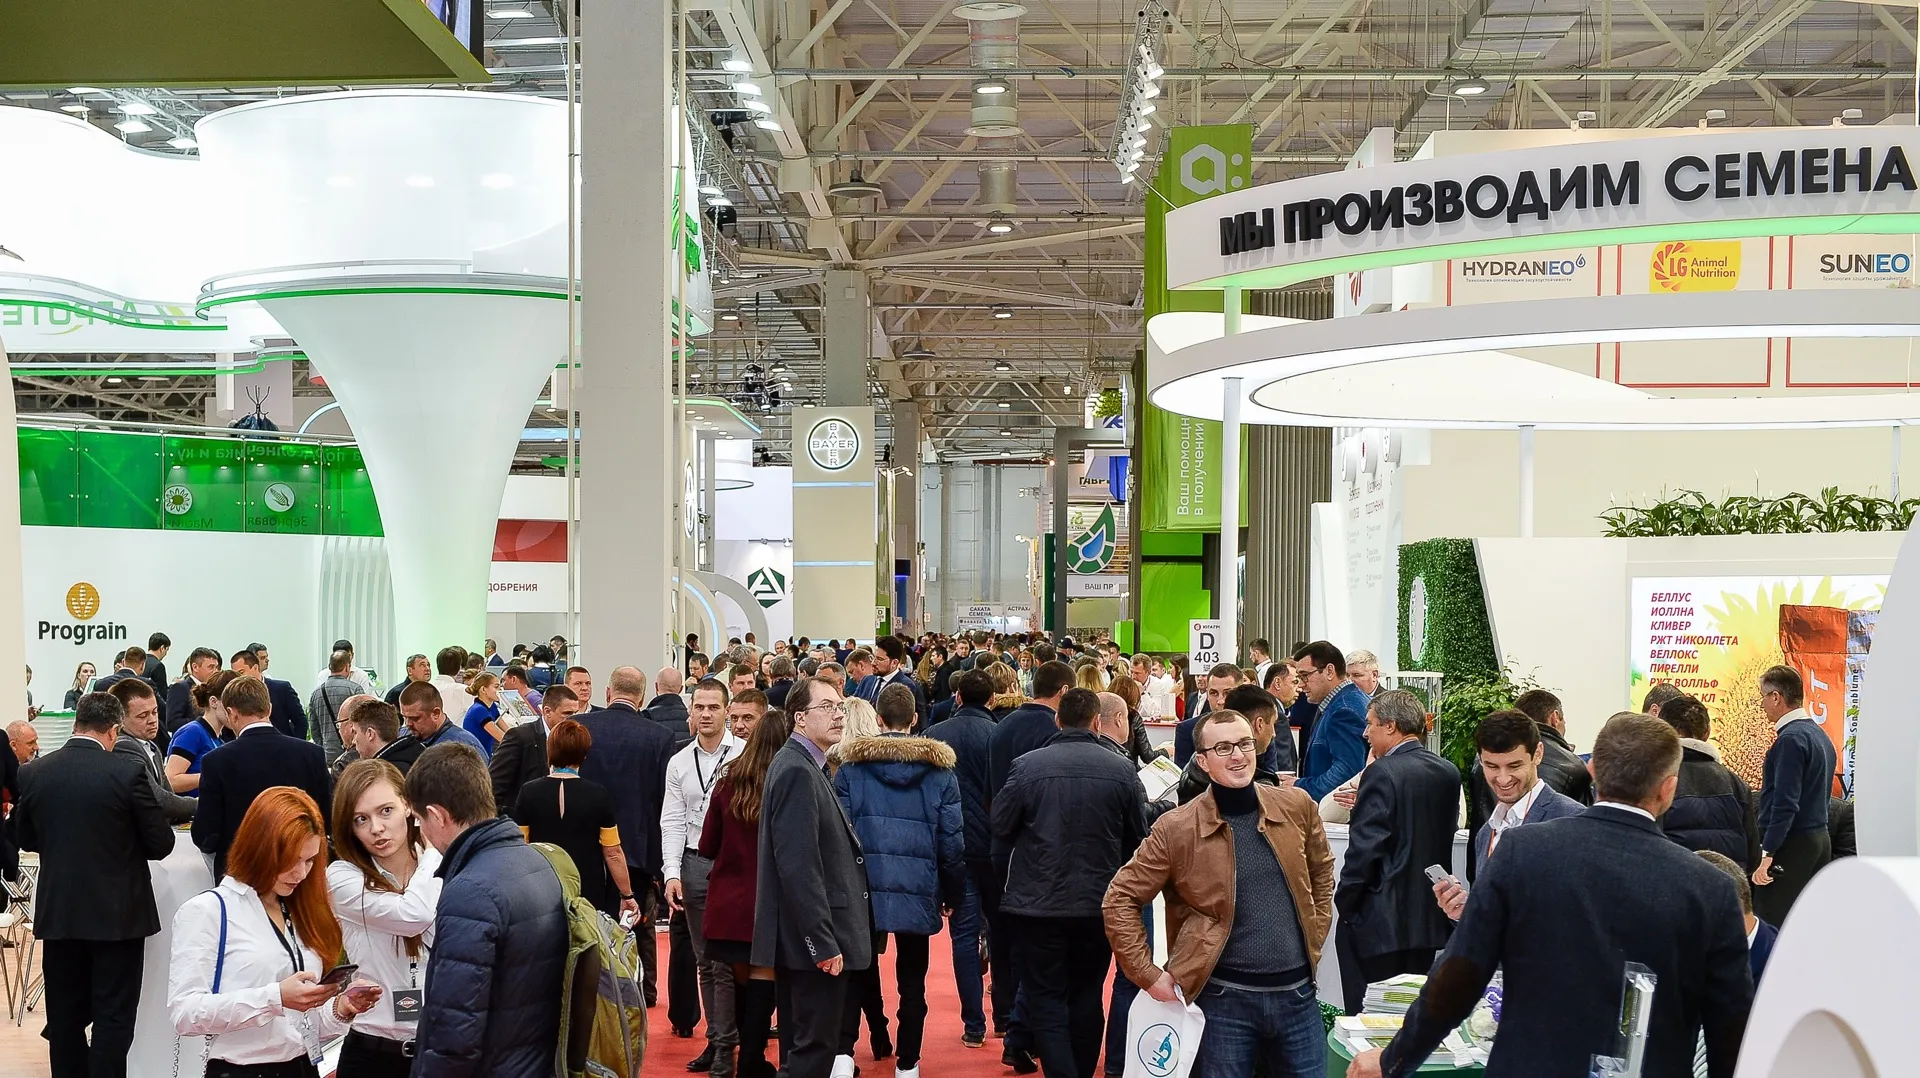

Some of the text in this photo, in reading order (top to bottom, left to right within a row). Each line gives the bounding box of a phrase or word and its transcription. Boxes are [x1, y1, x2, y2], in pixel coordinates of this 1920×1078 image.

[1220, 146, 1917, 256] МЫ ПРОИЗВОДИМ СЕМЕНА
[1691, 256, 1728, 267] Animal
[1820, 254, 1910, 273] SUNEO
[1463, 261, 1575, 276] HYDRANEO
[1669, 258, 1688, 277] LG
[1691, 268, 1736, 278] Nutrition
[812, 440, 854, 448] BAYER
[829, 423, 838, 466] BAYER
[1194, 423, 1207, 515] в получении
[1177, 483, 1190, 515] Ваш
[1651, 593, 1691, 603] БЕЛЛУС
[1651, 607, 1694, 617] ИОЛЛНА
[1650, 621, 1691, 631] КЛИВЕР
[38, 621, 127, 646] Prograin
[1200, 633, 1215, 650] D
[1650, 636, 1739, 646] РЖТ НИКОЛЛЕТА
[1194, 652, 1220, 663] 403
[1650, 650, 1698, 659] ВЕЛЛОКС
[1650, 664, 1699, 673] ПИРЕЛЛИ
[1675, 679, 1719, 689] ВОЛЛЬФ
[1701, 694, 1716, 702] КЛ
